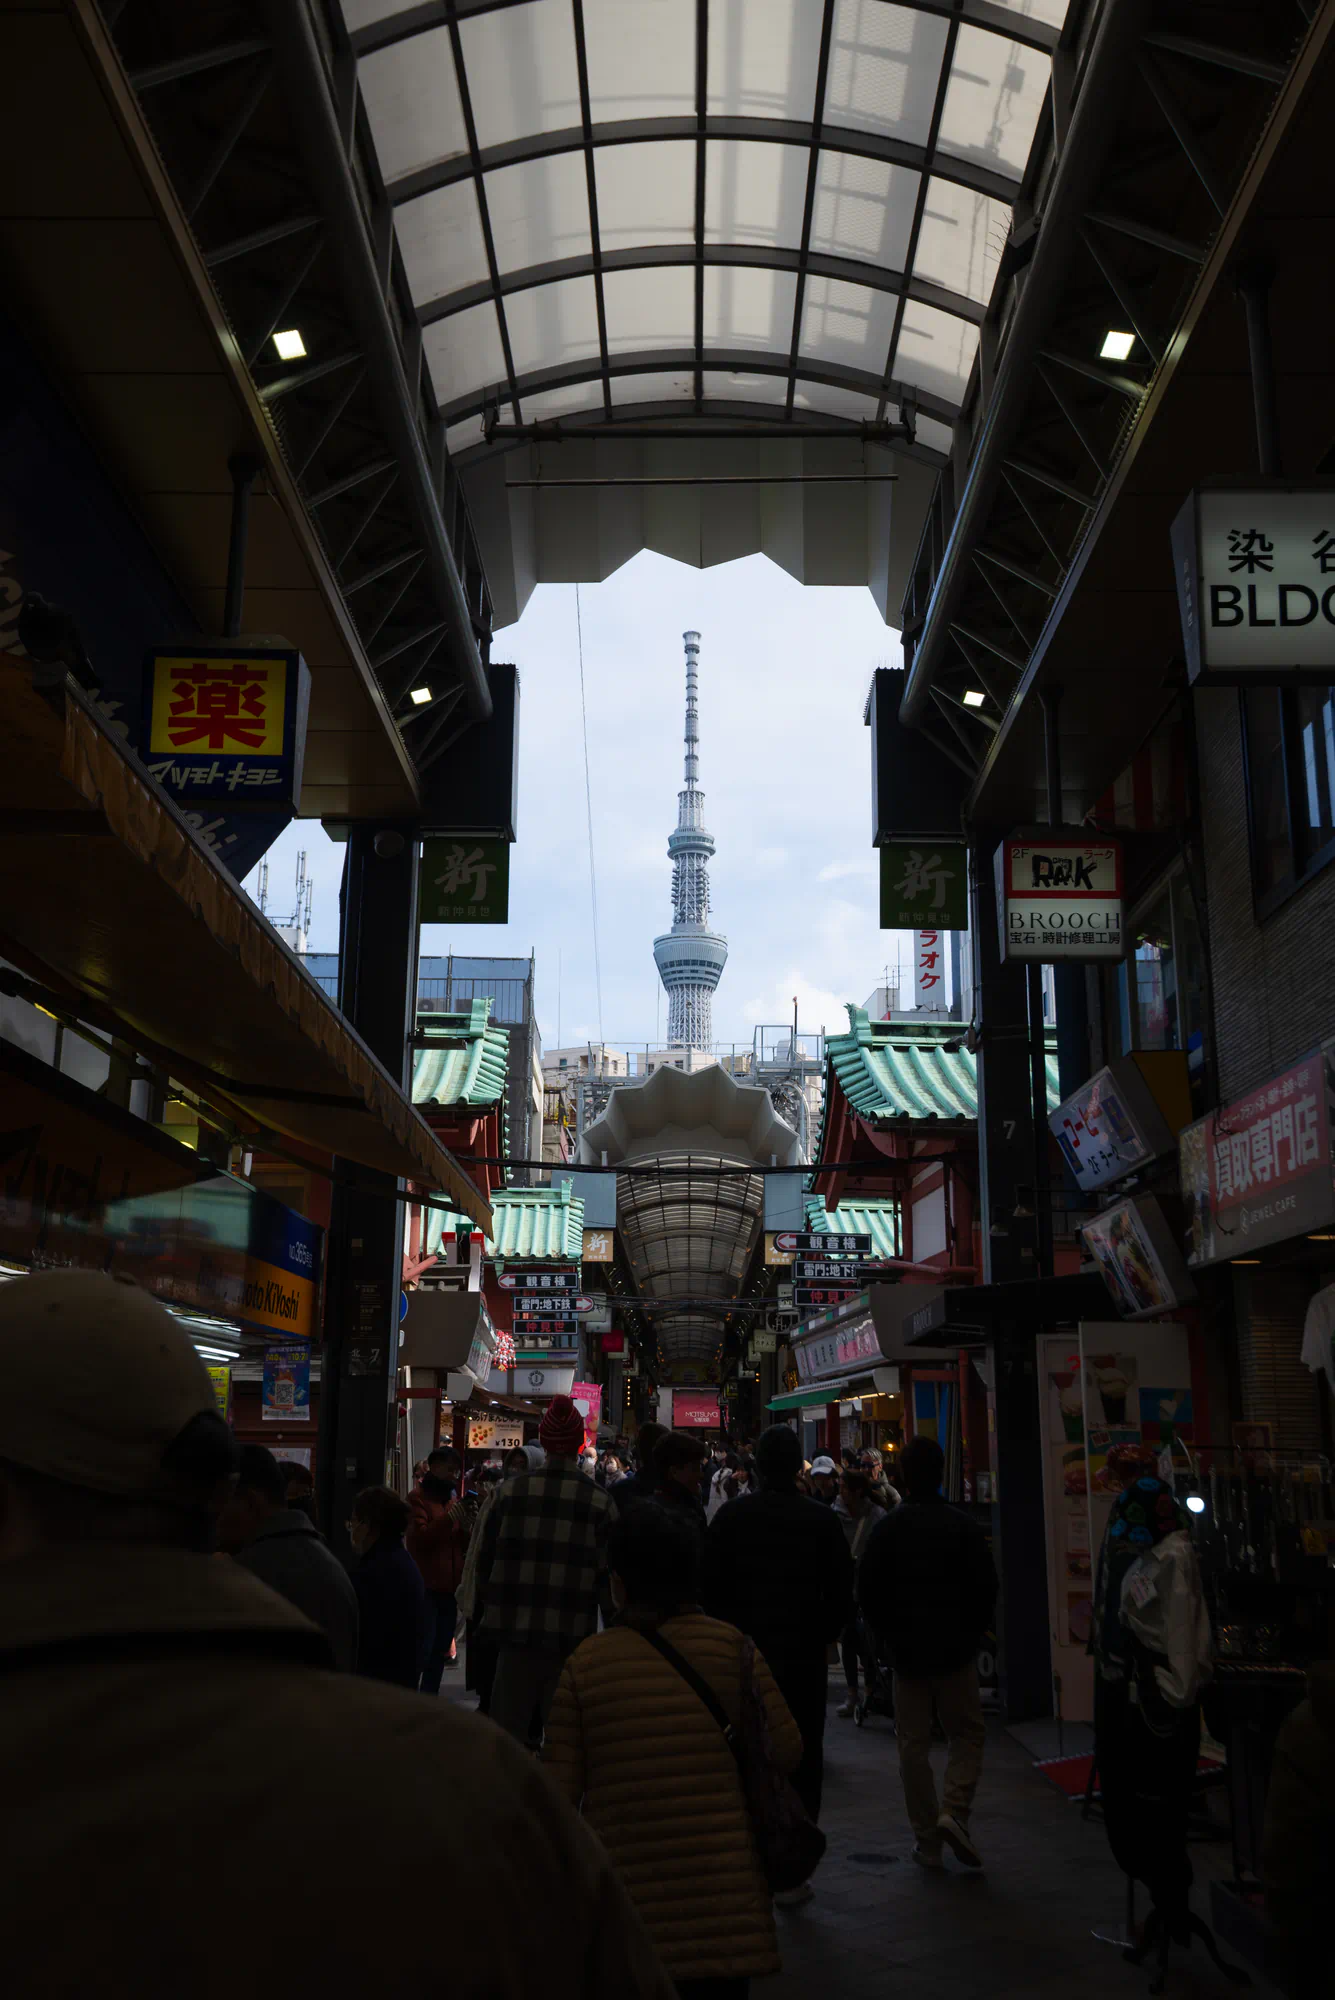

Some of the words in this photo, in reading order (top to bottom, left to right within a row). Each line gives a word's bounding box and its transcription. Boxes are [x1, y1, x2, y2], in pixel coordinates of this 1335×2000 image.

[167, 663, 269, 749] 薬
[148, 759, 283, 792] マツモトキヨシ
[1012, 848, 1030, 859] 2F
[434, 844, 497, 902] 新
[893, 850, 956, 909] 新
[1010, 912, 1120, 929] BROOCH
[1002, 1119, 1017, 1140] 7
[1213, 1093, 1320, 1203] 買取専門店
[587, 1233, 609, 1254] 新
[810, 1235, 857, 1250] 観音様
[526, 1275, 565, 1287] 観音様
